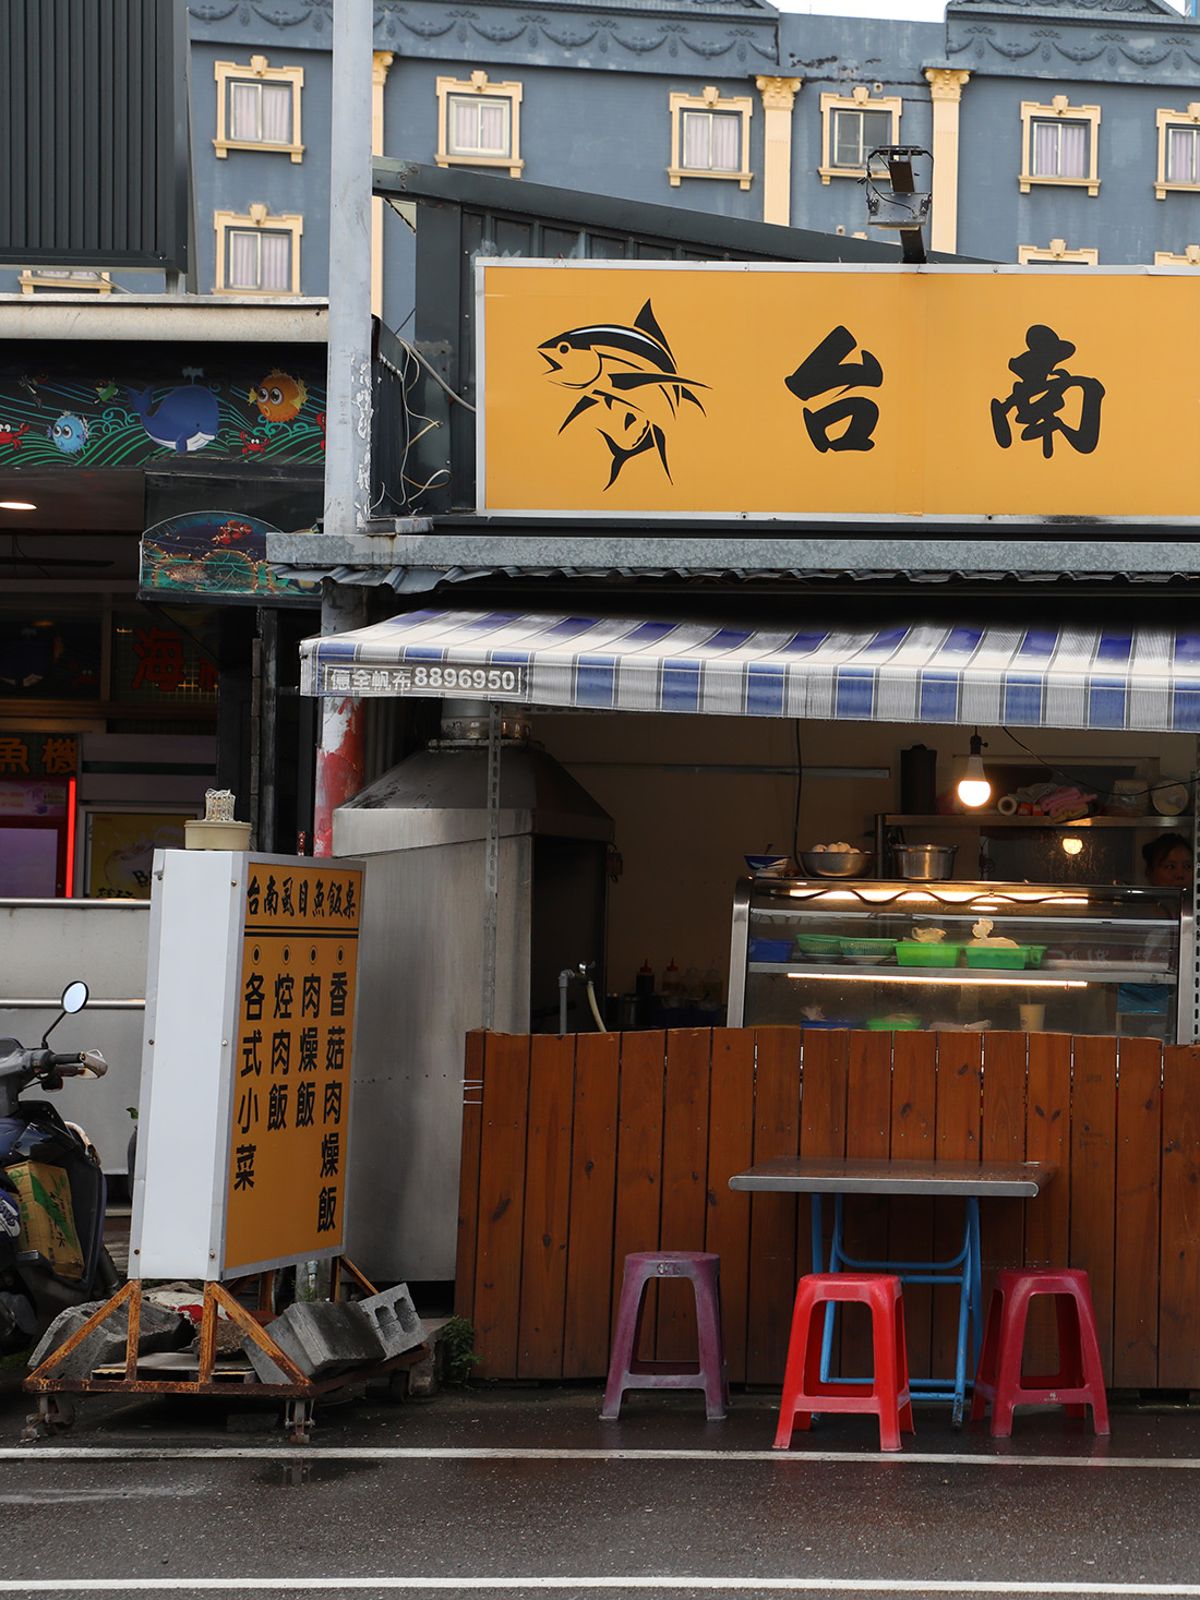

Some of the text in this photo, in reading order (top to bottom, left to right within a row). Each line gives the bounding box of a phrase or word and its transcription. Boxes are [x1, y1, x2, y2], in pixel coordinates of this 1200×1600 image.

[331, 666, 516, 692] 億全帆布 8896950
[247, 874, 356, 919] 台南虱目魚飯桌
[233, 972, 266, 1192] 各式小菜
[267, 972, 294, 1132] 焢肉飯
[295, 972, 322, 1129] 肉燥飯
[317, 971, 348, 1234] 香菇肉燥飯
